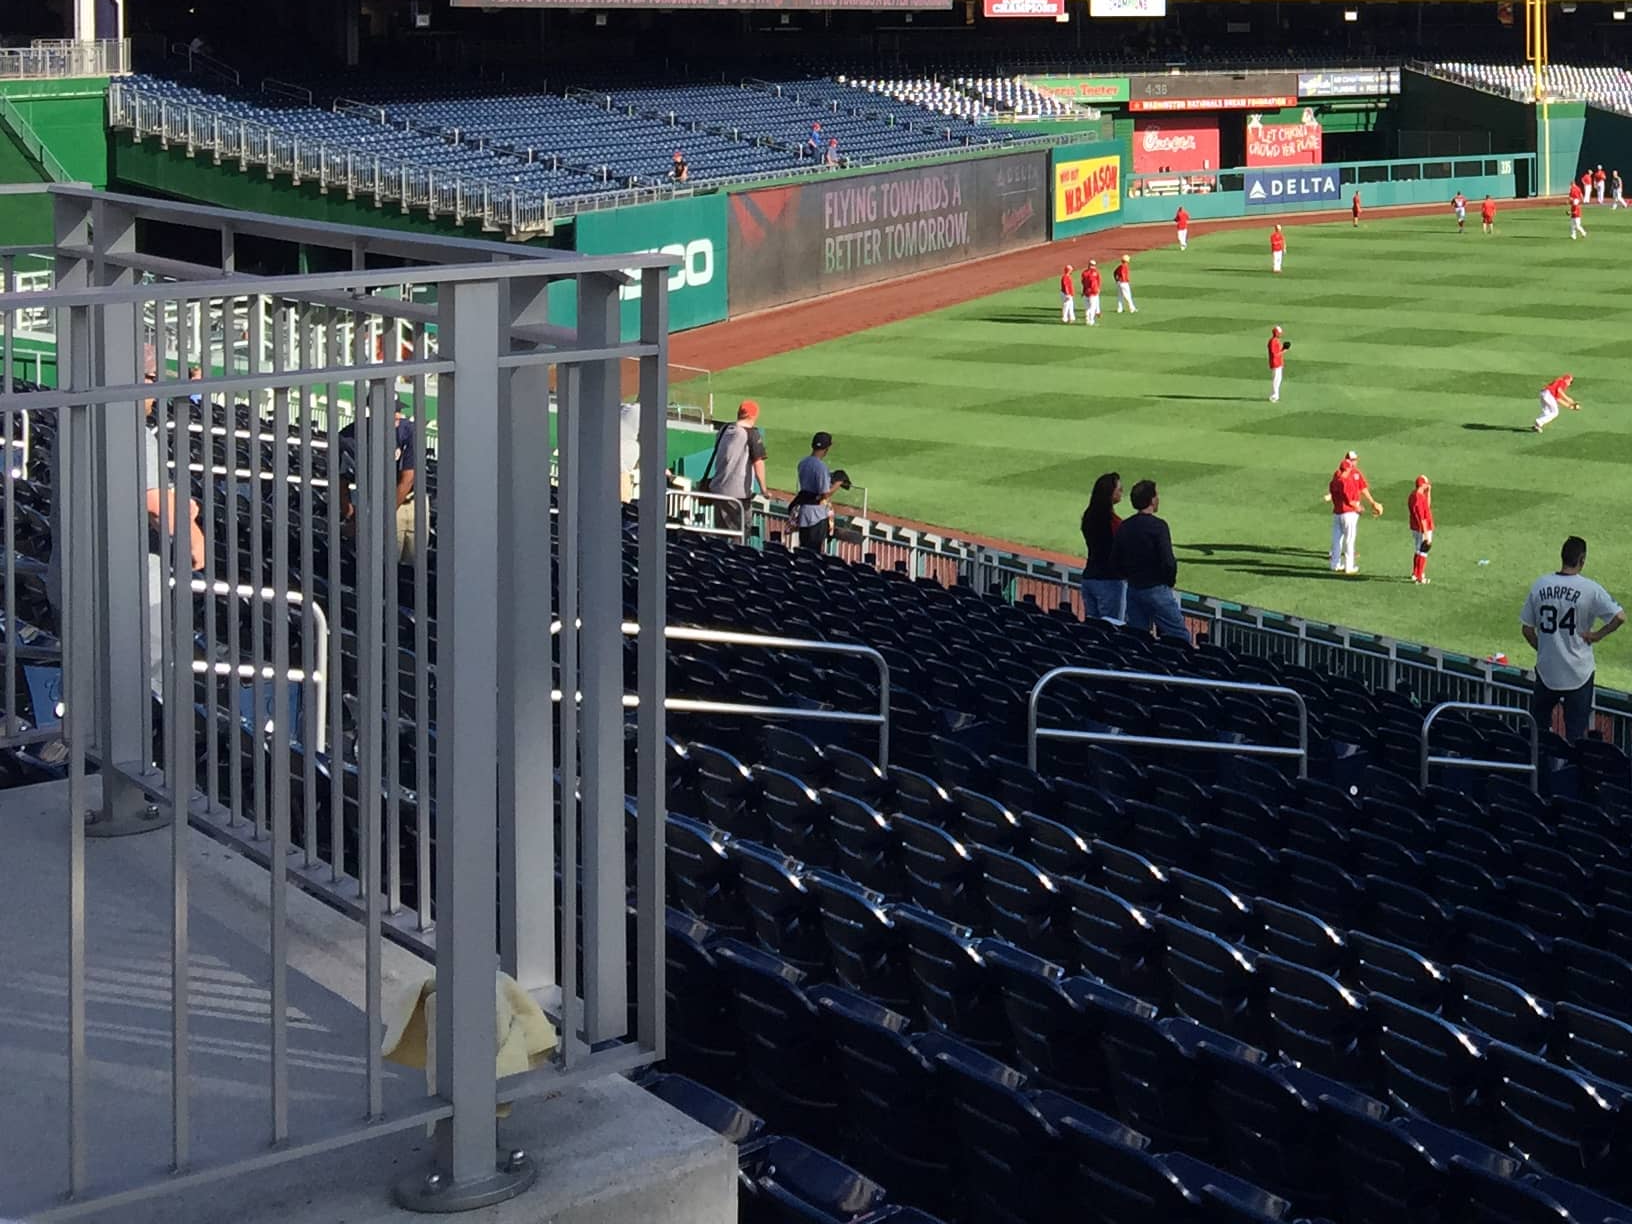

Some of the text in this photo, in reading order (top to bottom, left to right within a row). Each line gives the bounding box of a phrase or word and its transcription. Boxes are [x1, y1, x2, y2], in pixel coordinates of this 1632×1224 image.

[1261, 128, 1277, 143] LET
[1271, 176, 1336, 196] DELTA
[825, 173, 962, 229] FLYING TOWARDS A
[825, 231, 882, 274] BETTER
[1539, 586, 1581, 604] HARPER
[1539, 605, 1576, 636] 34
